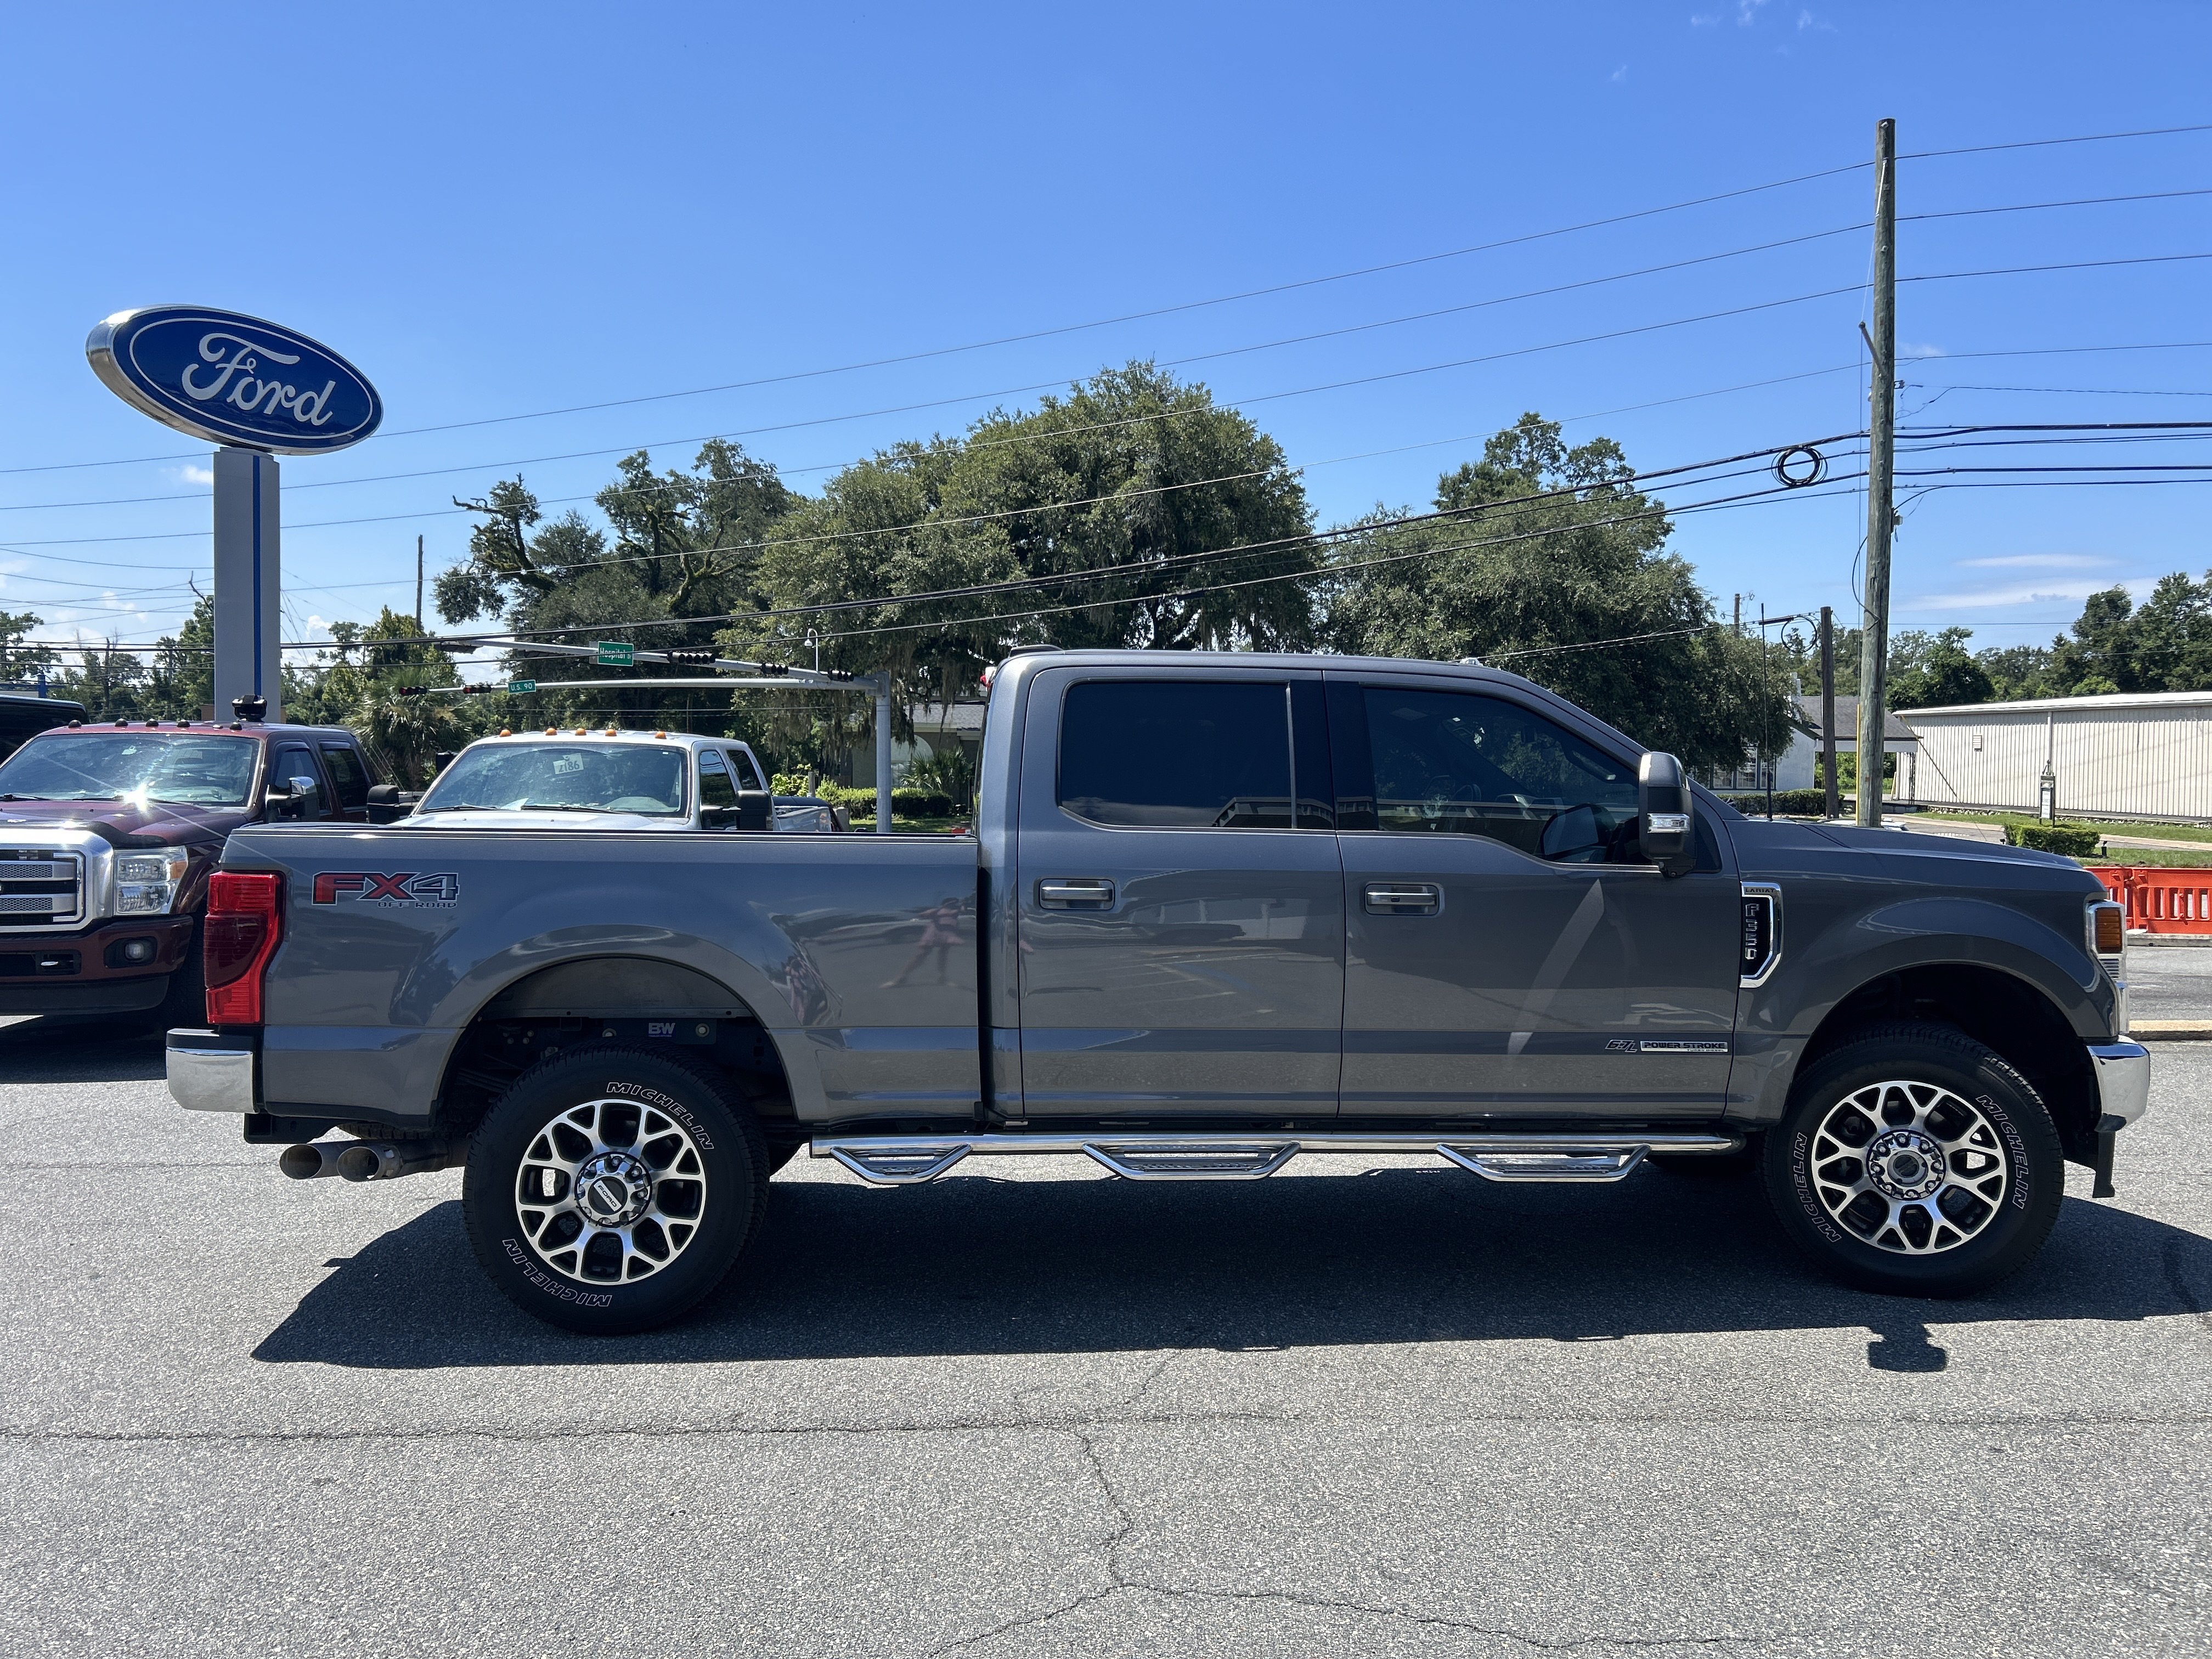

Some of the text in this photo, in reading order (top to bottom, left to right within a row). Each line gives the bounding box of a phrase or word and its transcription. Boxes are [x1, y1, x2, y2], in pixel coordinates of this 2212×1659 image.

[182, 332, 336, 426] Ford
[600, 647, 625, 661] Hospital
[312, 871, 460, 906] FX4
[414, 901, 458, 909] ROAD
[606, 1082, 714, 1150] MICHELIN
[1976, 1094, 2030, 1210] MICHELIN
[597, 1185, 617, 1207] FORD
[1793, 1132, 1842, 1242] MICHELIN
[503, 1239, 613, 1307] MICHELIN
